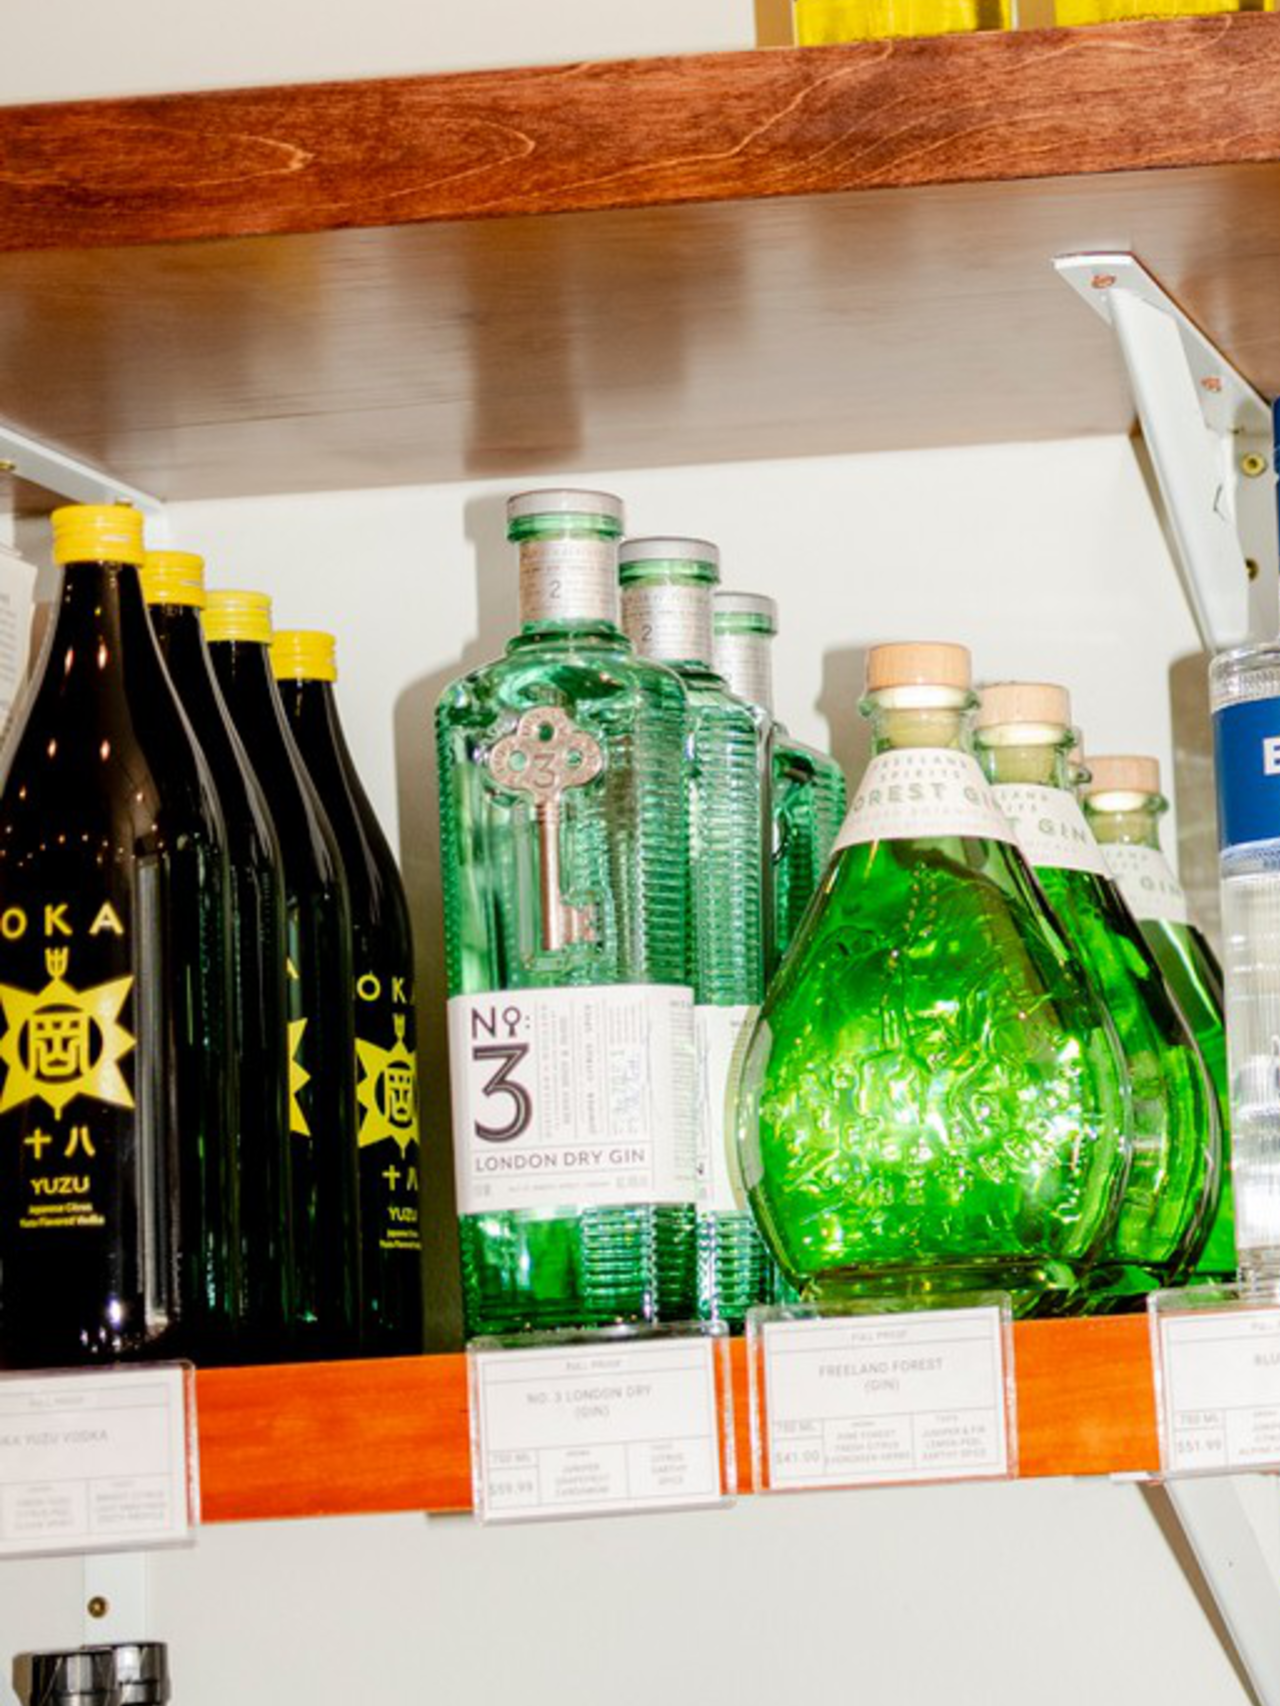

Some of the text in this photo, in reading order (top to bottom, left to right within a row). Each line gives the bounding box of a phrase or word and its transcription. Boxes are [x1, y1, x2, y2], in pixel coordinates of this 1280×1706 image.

[0, 900, 124, 940] OKA
[472, 1043, 533, 1142] 3
[475, 1148, 645, 1173] LONDON DRY GIN
[31, 1175, 90, 1195] YUZU
